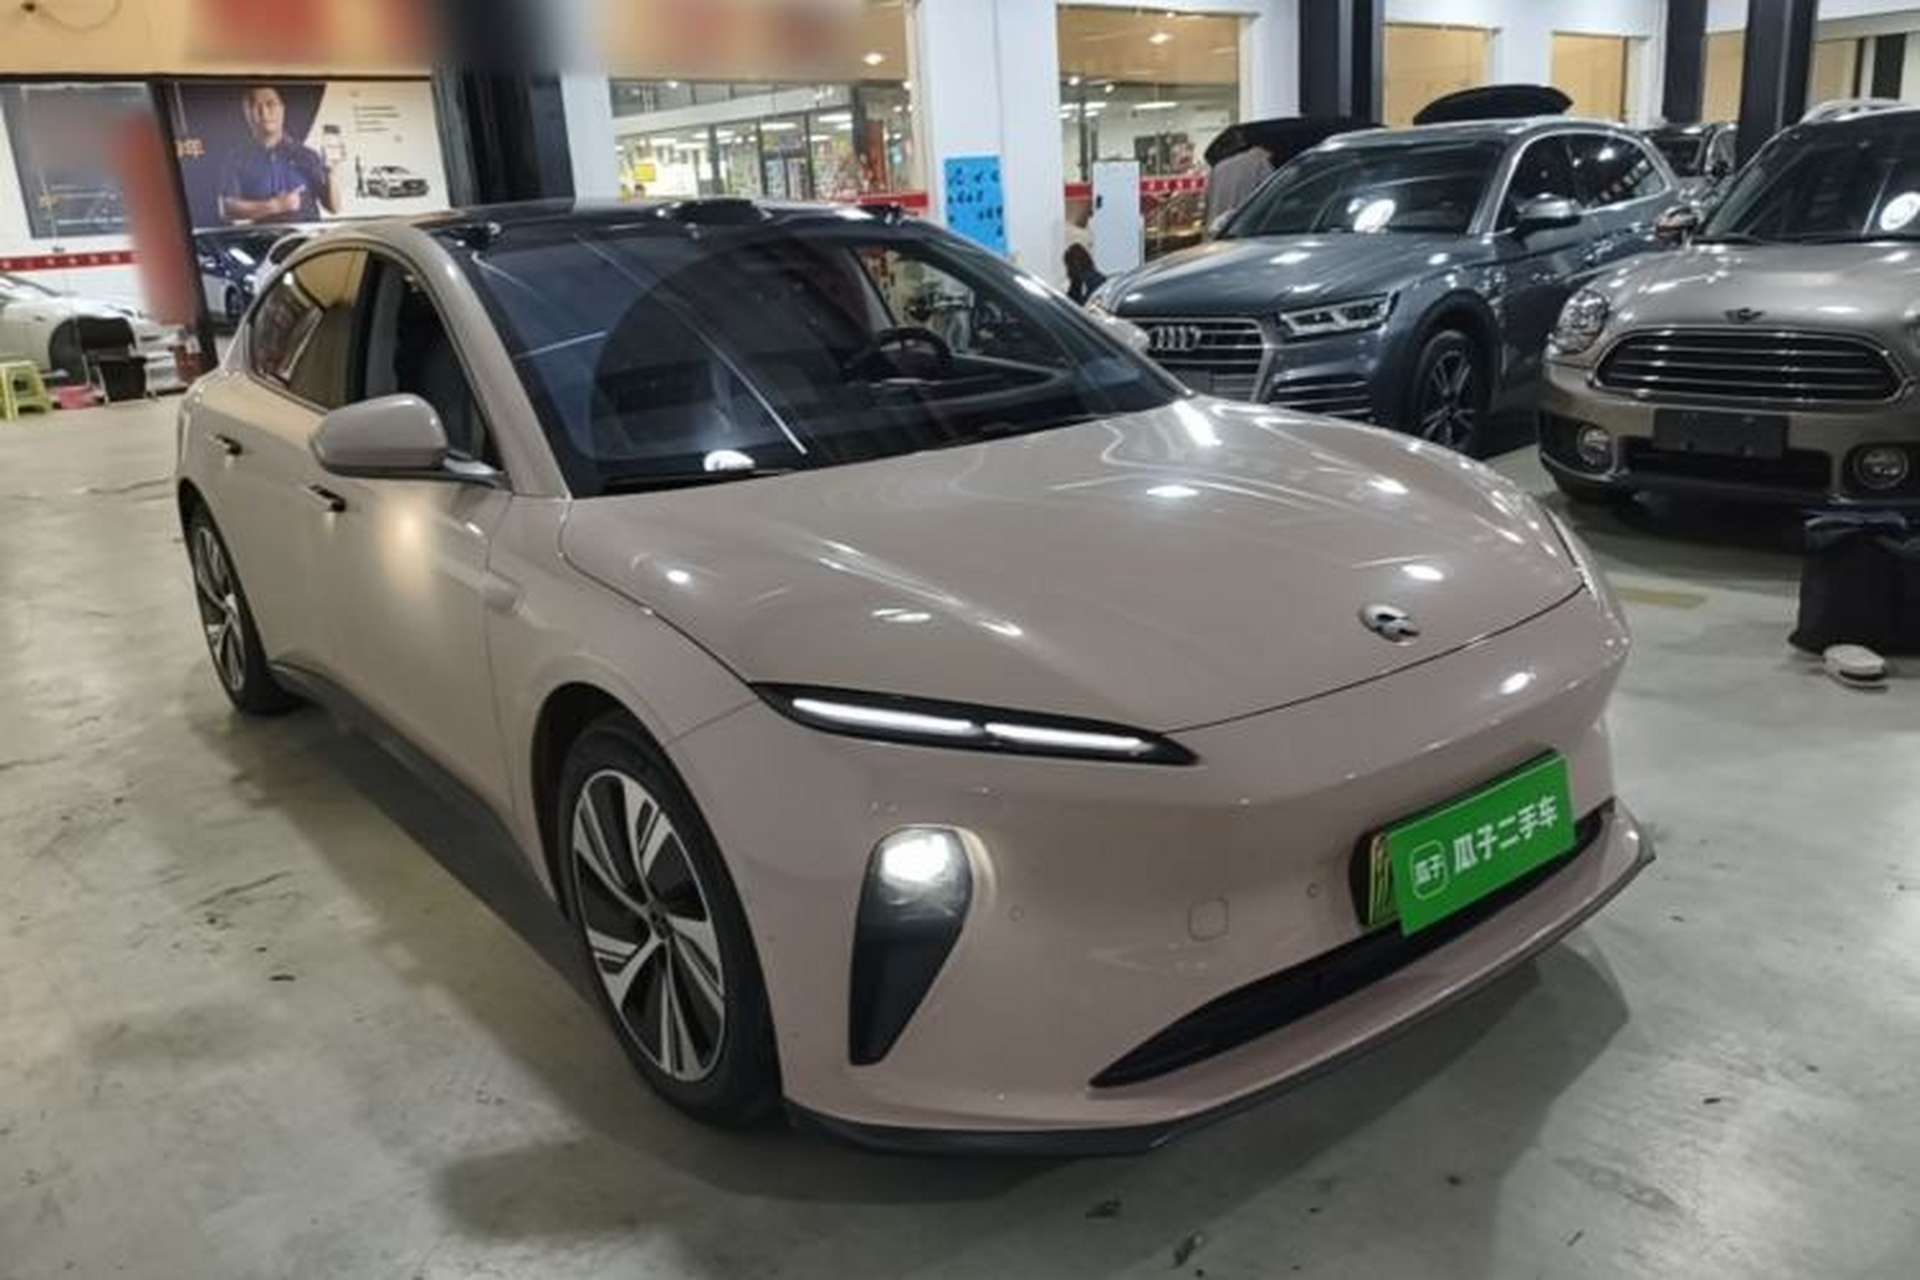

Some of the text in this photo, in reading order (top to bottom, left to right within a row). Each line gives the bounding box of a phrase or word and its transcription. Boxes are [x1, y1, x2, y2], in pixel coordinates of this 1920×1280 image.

[1453, 796, 1557, 874] 瓜子二手车
